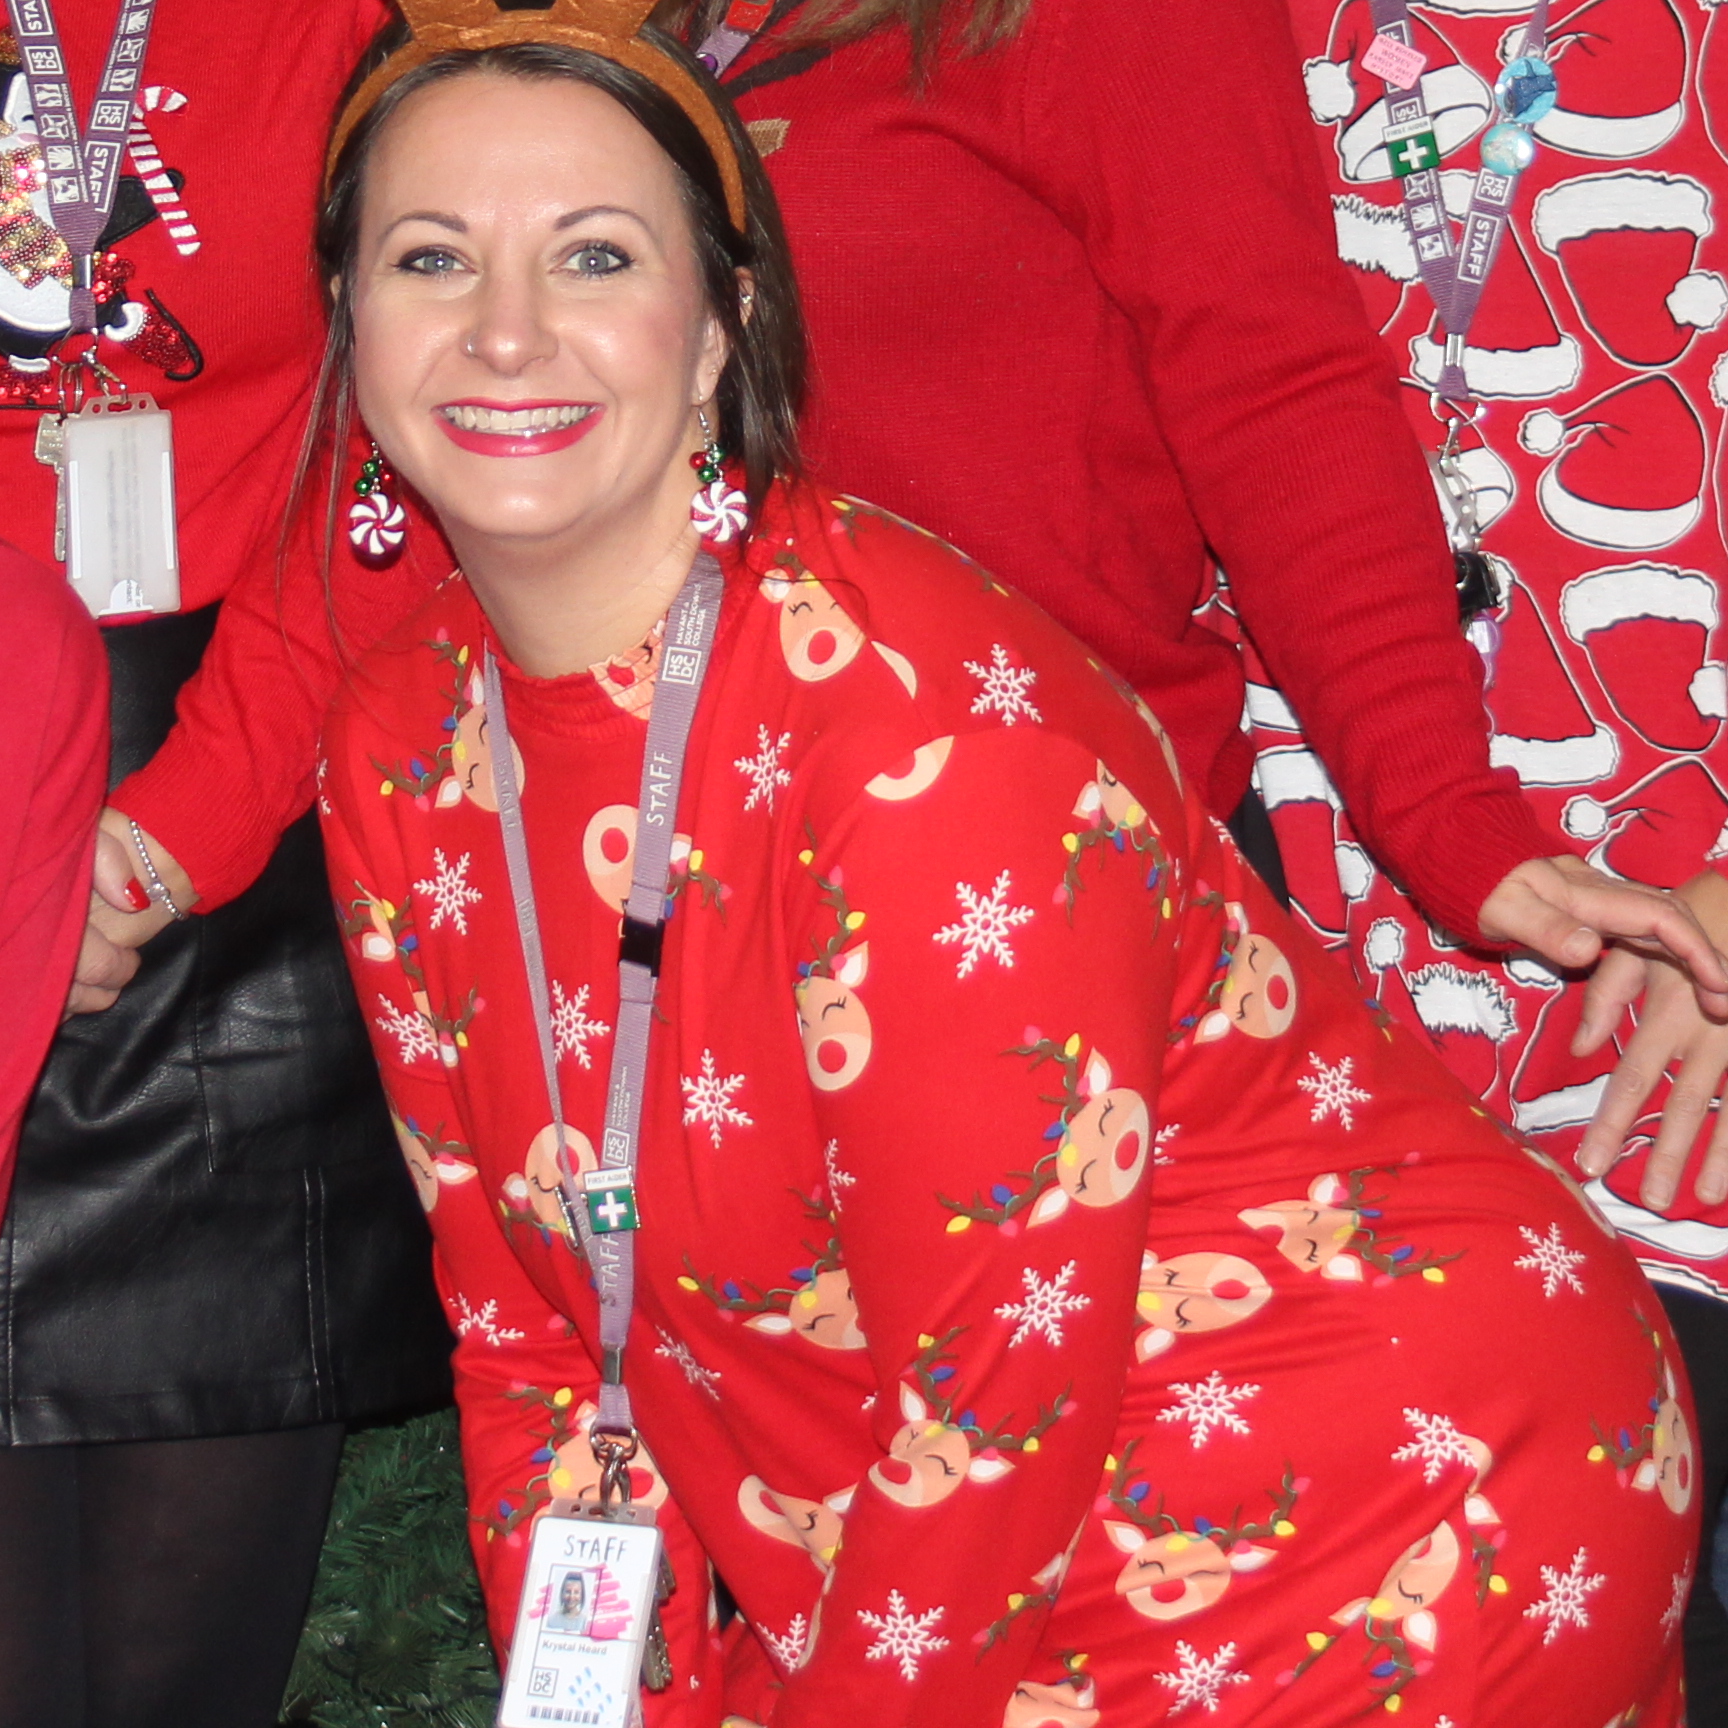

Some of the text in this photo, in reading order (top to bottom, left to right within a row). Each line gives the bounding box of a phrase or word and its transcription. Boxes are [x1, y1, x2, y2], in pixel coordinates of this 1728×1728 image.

[32, 50, 45, 72] HS
[45, 49, 58, 70] DC
[97, 103, 110, 124] DC
[110, 103, 122, 125] HS
[1479, 174, 1494, 196] DC
[1491, 175, 1507, 198] HS
[1469, 220, 1492, 278] STAFF
[676, 610, 688, 644] HAVANT
[684, 615, 696, 646] SOUTH
[669, 654, 683, 676] HS
[681, 656, 696, 678] DC
[646, 751, 672, 826] STAFF
[606, 1136, 617, 1159] HS
[615, 1136, 626, 1160] DC
[587, 1172, 628, 1185] FIRST AIDER
[563, 1534, 629, 1563] STAFF
[542, 1640, 608, 1656] Krystal Heard
[533, 1681, 552, 1693] DC
[535, 1669, 552, 1683] HS
